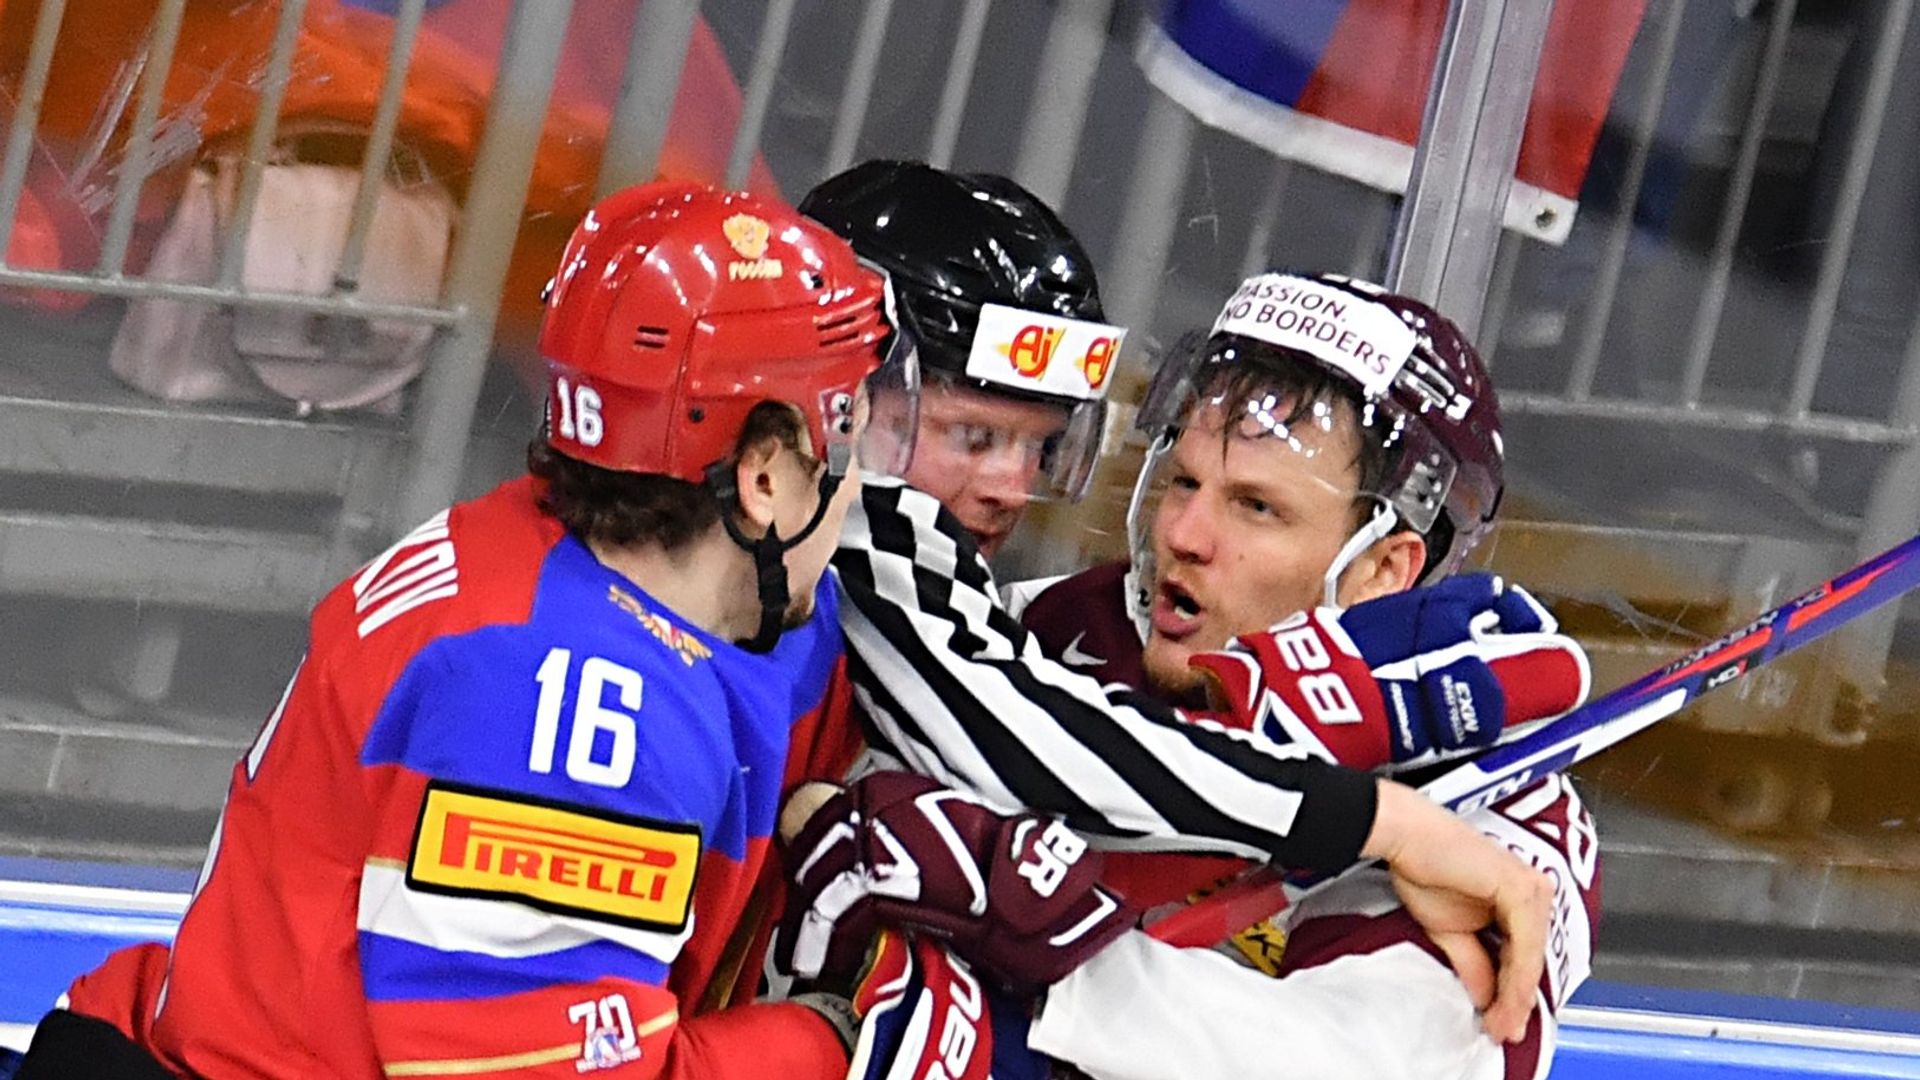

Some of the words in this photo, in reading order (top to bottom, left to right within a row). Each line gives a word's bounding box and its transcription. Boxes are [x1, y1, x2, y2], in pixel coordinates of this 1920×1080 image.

[1255, 303, 1391, 375] BORDERS
[556, 376, 604, 446] 16
[529, 647, 644, 789] 16
[439, 811, 677, 902] PIRELLI
[568, 993, 638, 1064] 70
